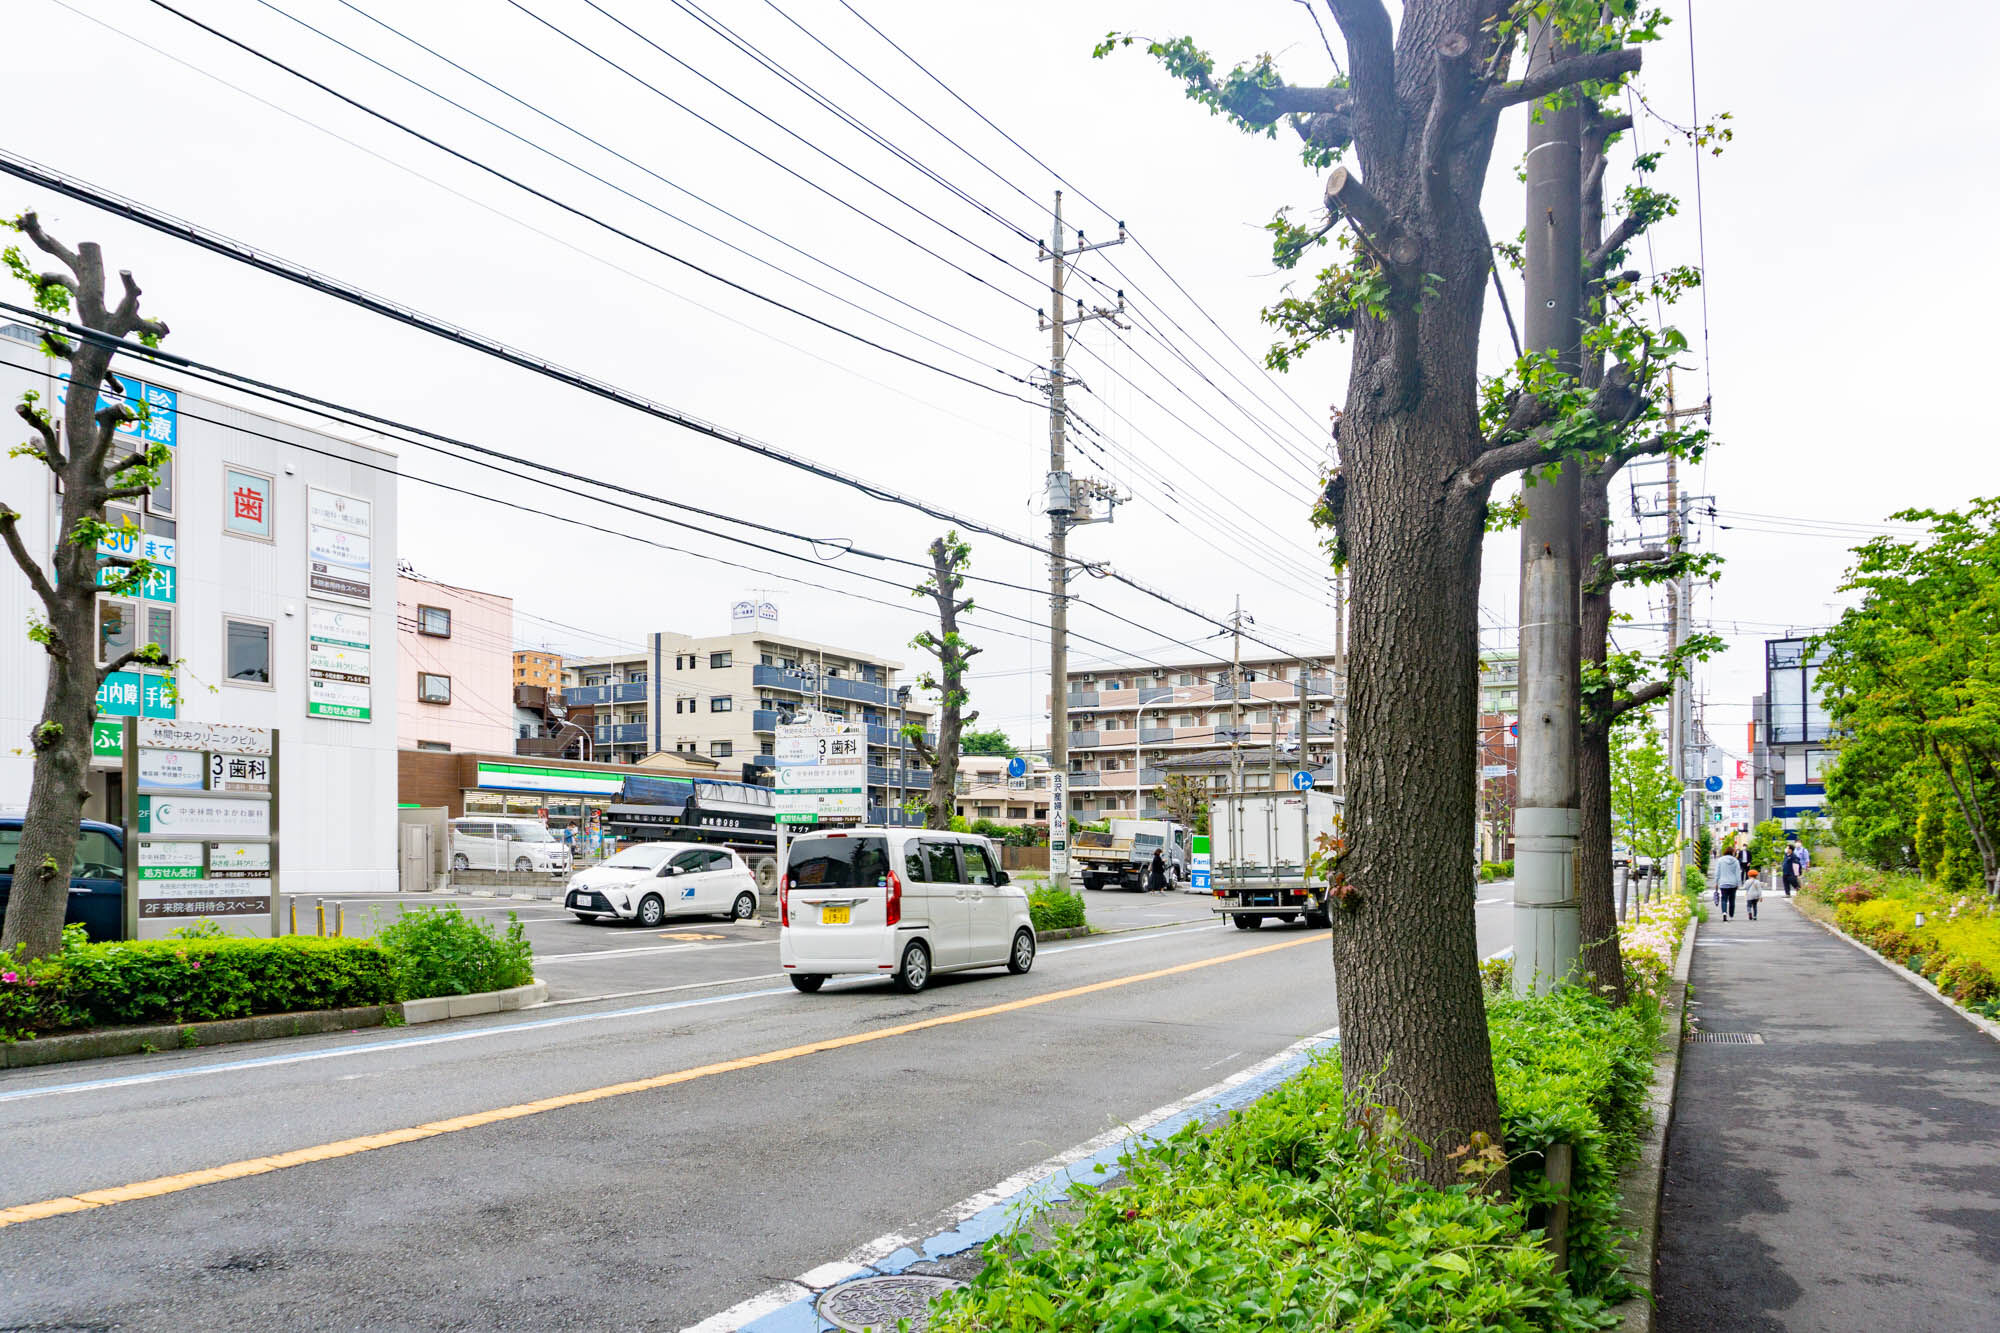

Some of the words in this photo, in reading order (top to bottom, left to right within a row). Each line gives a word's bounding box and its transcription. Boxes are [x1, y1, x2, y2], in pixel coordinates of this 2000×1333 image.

[148, 388, 172, 441] 診療
[234, 487, 264, 524] 歯
[153, 728, 257, 746] 林間中央クリニックビル
[831, 739, 857, 755] 歯科
[228, 758, 267, 780] 歯科
[138, 809, 151, 818] 2F
[143, 867, 198, 879] 処方せん受付
[144, 903, 160, 913] 2F
[162, 900, 265, 914] 来院者用待合スペース
